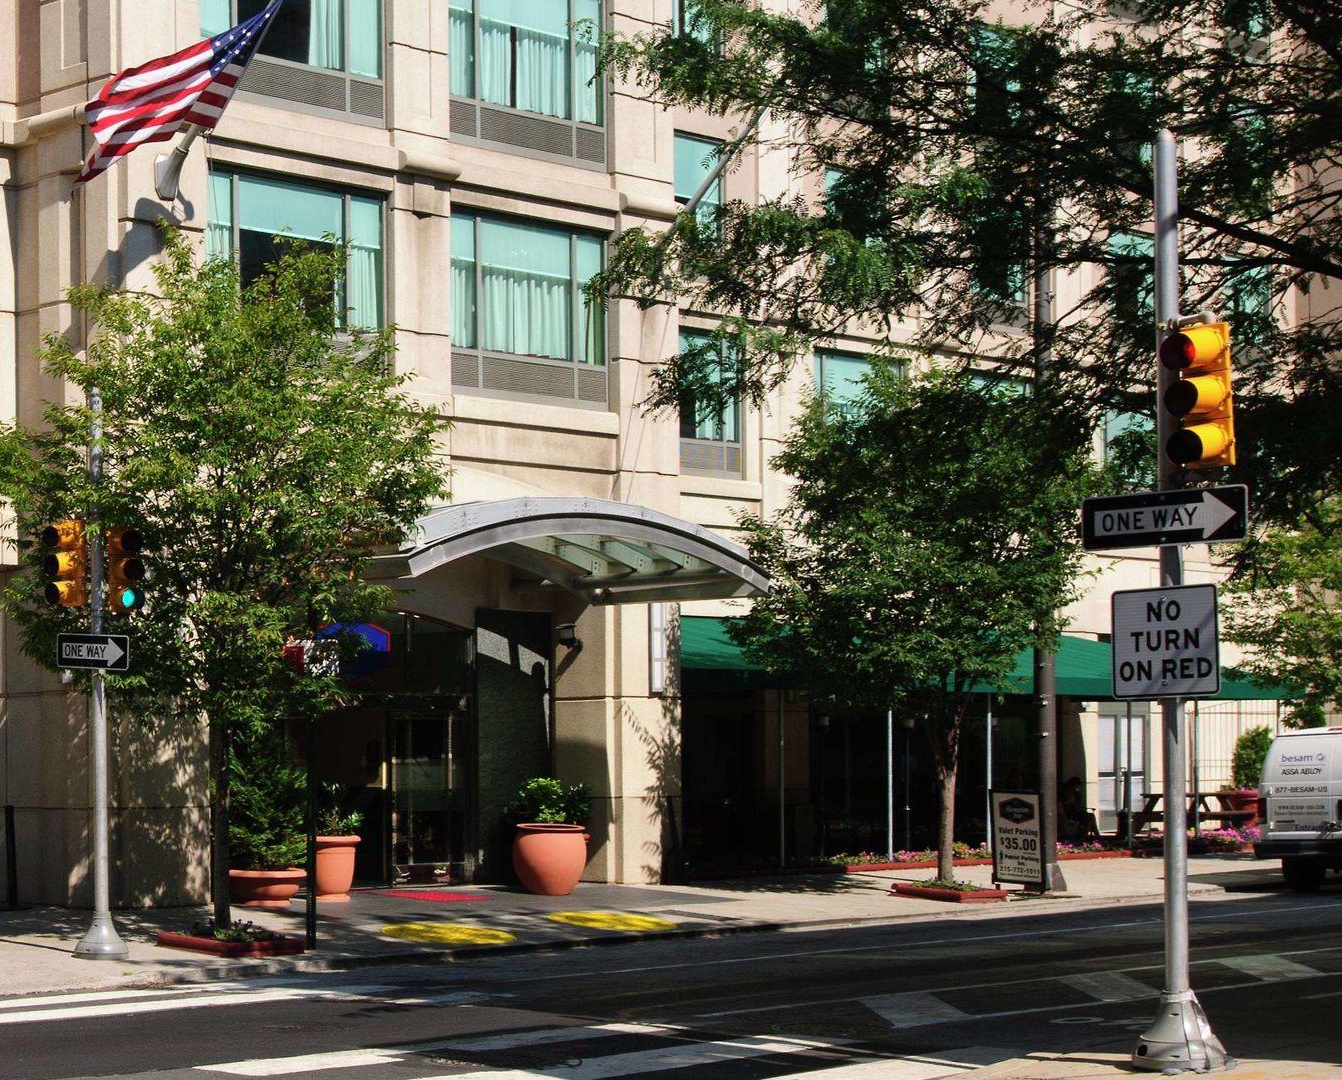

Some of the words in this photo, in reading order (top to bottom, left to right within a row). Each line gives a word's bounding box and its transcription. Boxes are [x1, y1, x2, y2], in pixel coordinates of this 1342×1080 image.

[1102, 511, 1145, 533] ONE
[1152, 506, 1198, 528] WAY
[1146, 600, 1181, 622] NO
[1130, 628, 1200, 652] TURN
[64, 644, 83, 657] ONE
[86, 646, 106, 658] WAY
[1119, 660, 1152, 682] ON
[1162, 657, 1213, 680] RED
[1281, 754, 1313, 762] besam
[1300, 767, 1322, 775] ABLOY
[1015, 828, 1038, 838] Parking
[1000, 836, 1036, 851] $35.00
